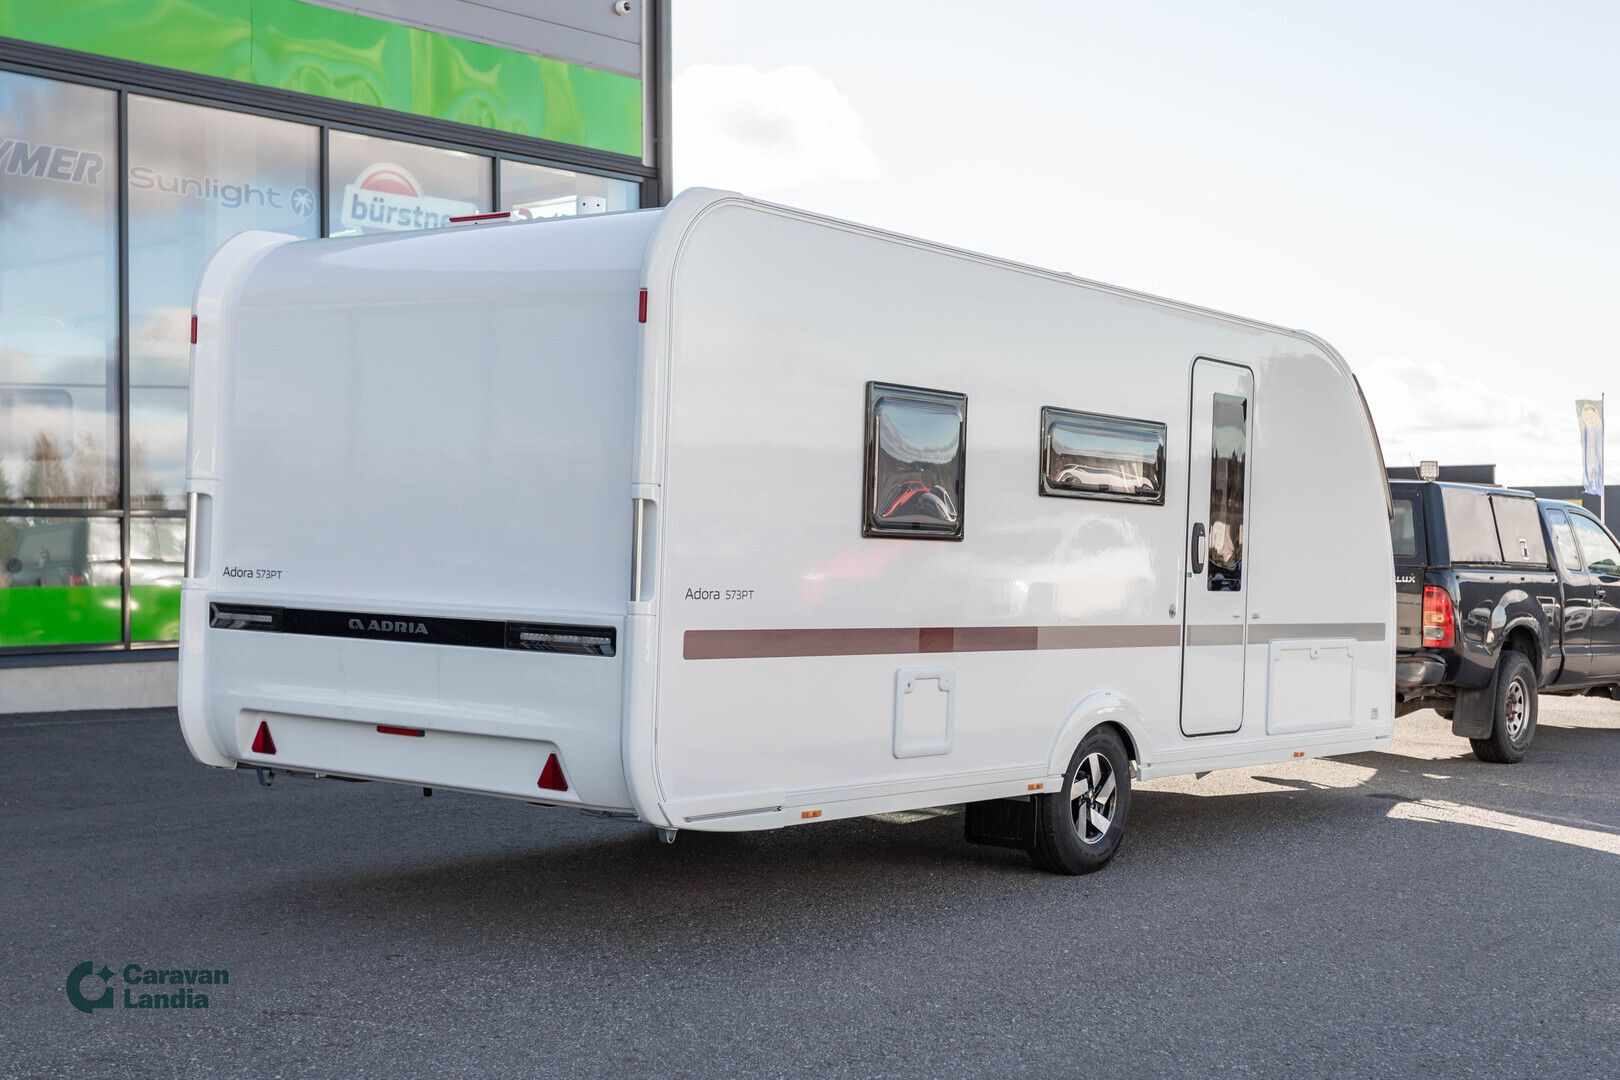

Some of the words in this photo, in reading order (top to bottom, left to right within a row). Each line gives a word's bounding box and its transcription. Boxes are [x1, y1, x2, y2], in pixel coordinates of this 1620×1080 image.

[129, 166, 283, 209] Sunlight
[222, 566, 254, 578] Adora
[255, 569, 283, 580] 573PT
[684, 587, 720, 600] Adora
[725, 589, 755, 600] 573PT
[367, 620, 429, 635] ADRIA
